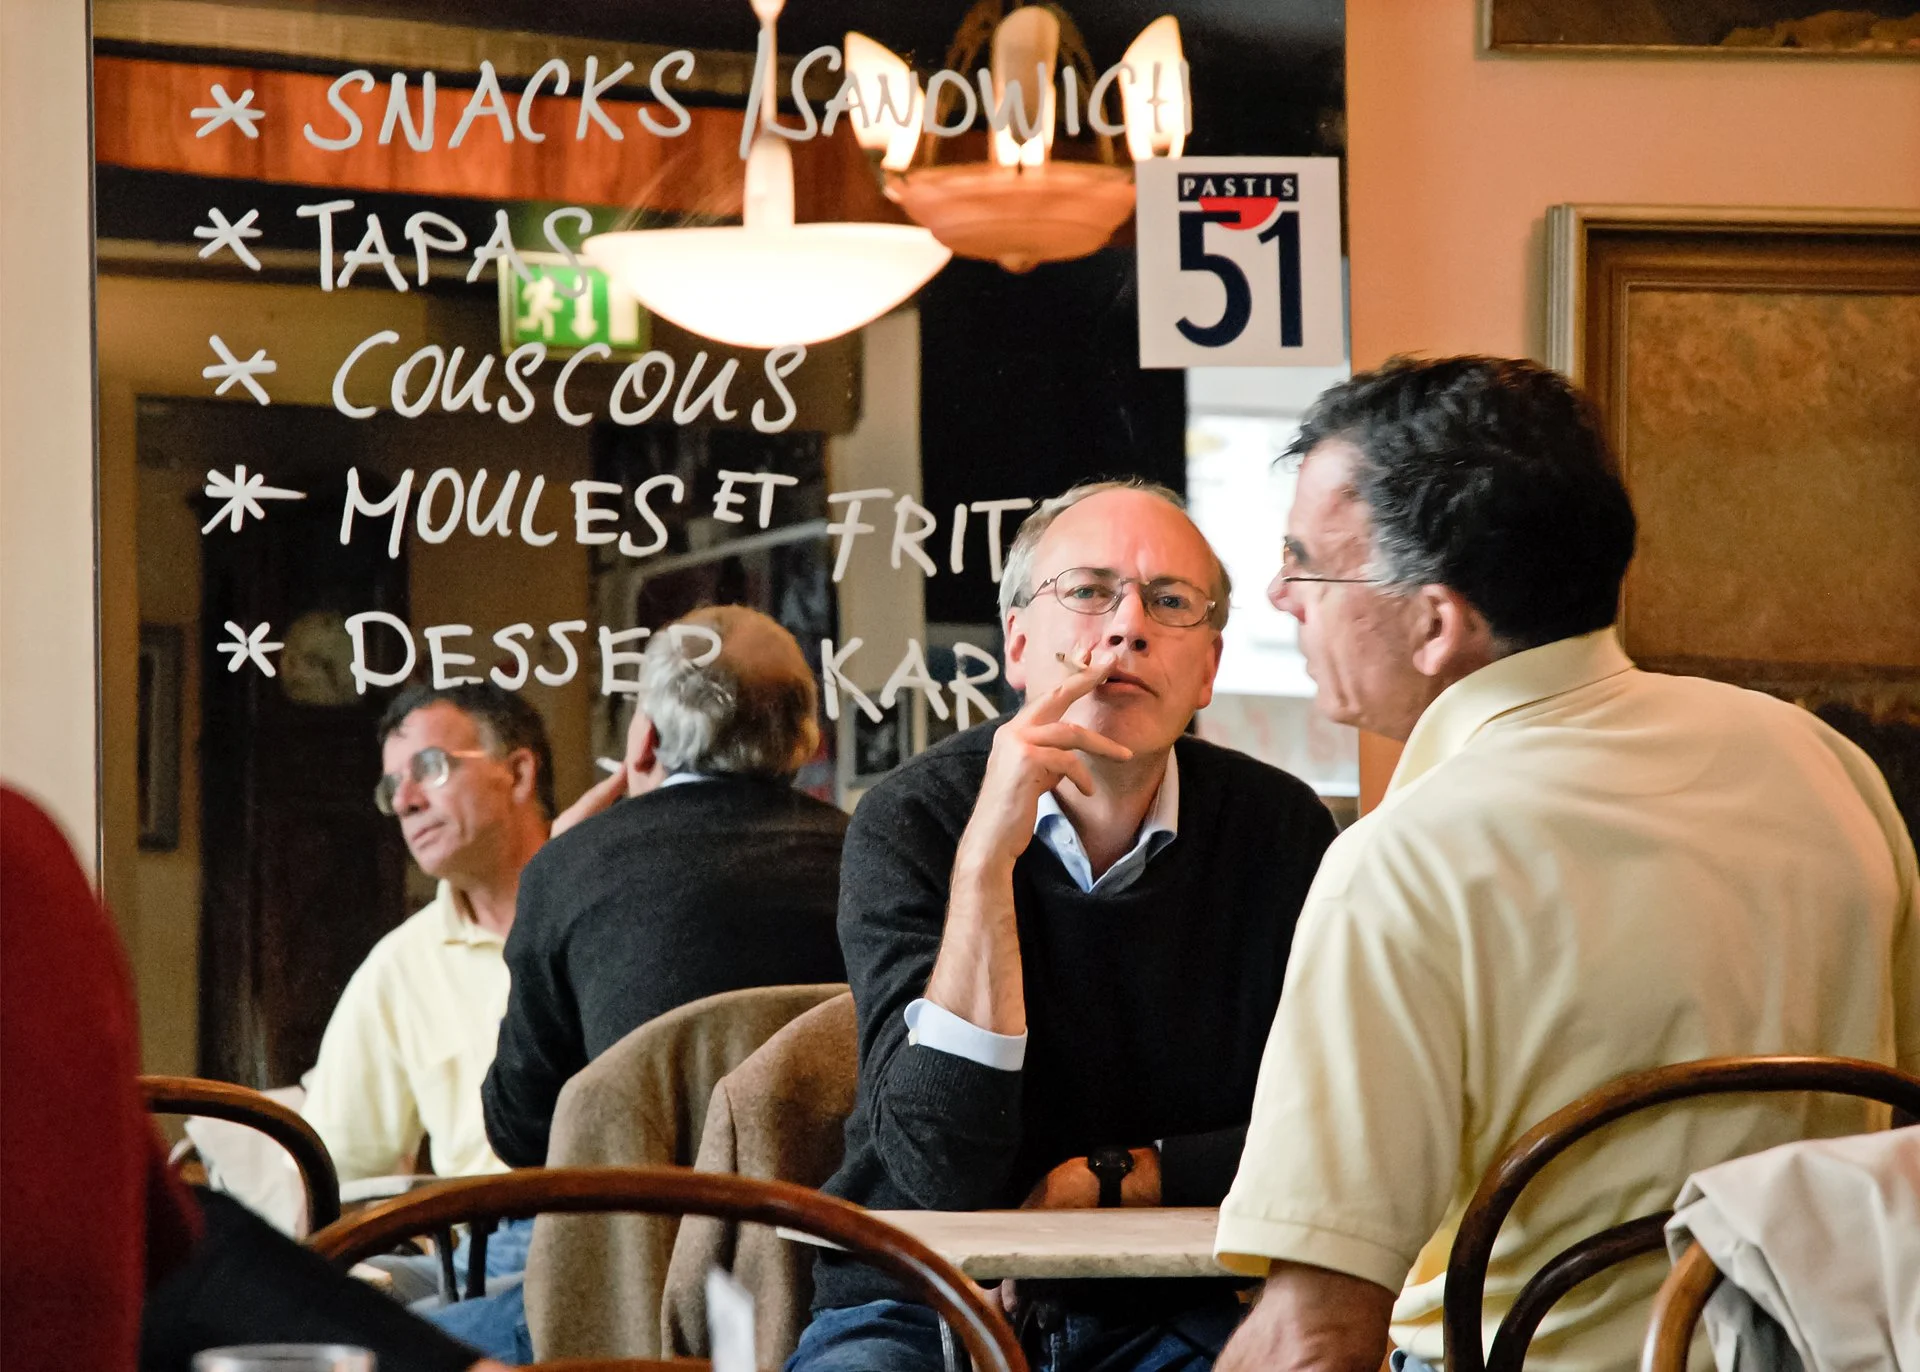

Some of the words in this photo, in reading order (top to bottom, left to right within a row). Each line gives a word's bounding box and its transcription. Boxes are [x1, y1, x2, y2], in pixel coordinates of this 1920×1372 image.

[303, 49, 695, 152] SNACKS
[1182, 177, 1295, 198] PASTIS
[296, 199, 593, 298] TAPAS
[1175, 210, 1303, 348] 51
[332, 330, 807, 434] COUSCOUS
[339, 466, 685, 558] MOULES
[713, 469, 799, 528] ET
